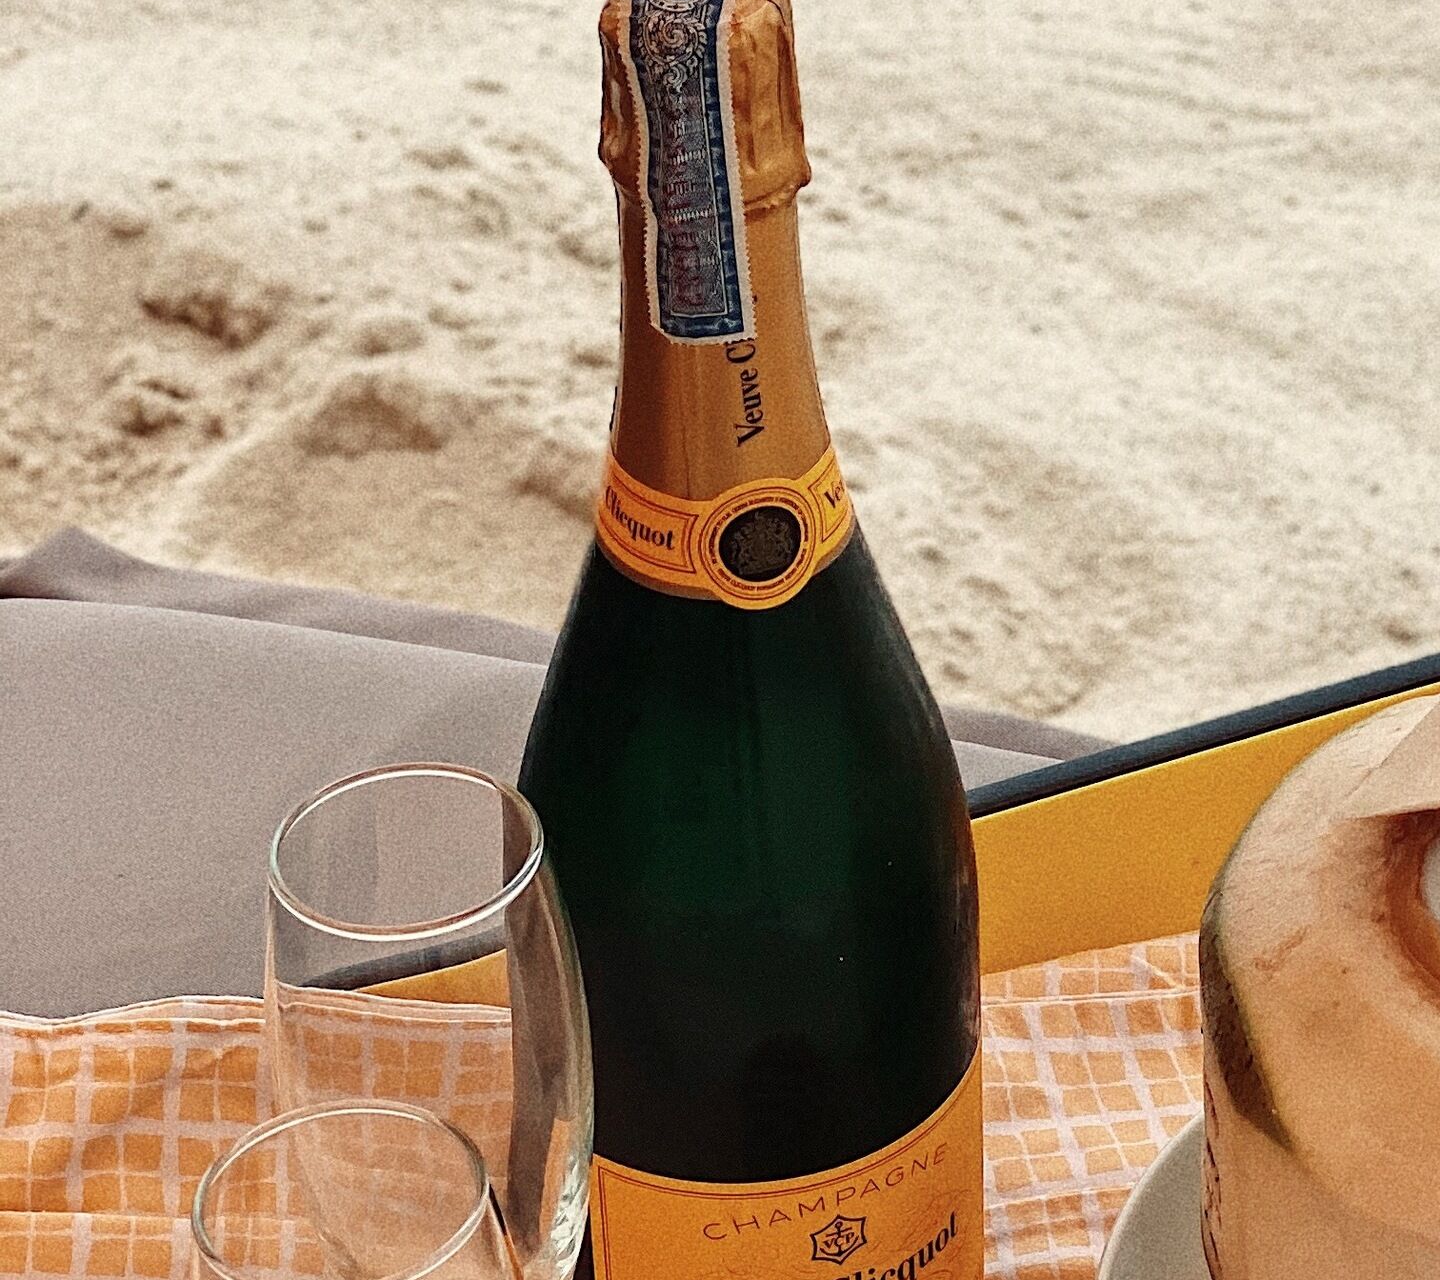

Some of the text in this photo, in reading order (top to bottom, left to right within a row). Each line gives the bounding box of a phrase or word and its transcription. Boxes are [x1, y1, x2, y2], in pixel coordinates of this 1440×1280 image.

[733, 368, 765, 447] Veuve
[605, 485, 675, 551] Clicquot
[702, 1142, 948, 1241] CHAMPAGNE
